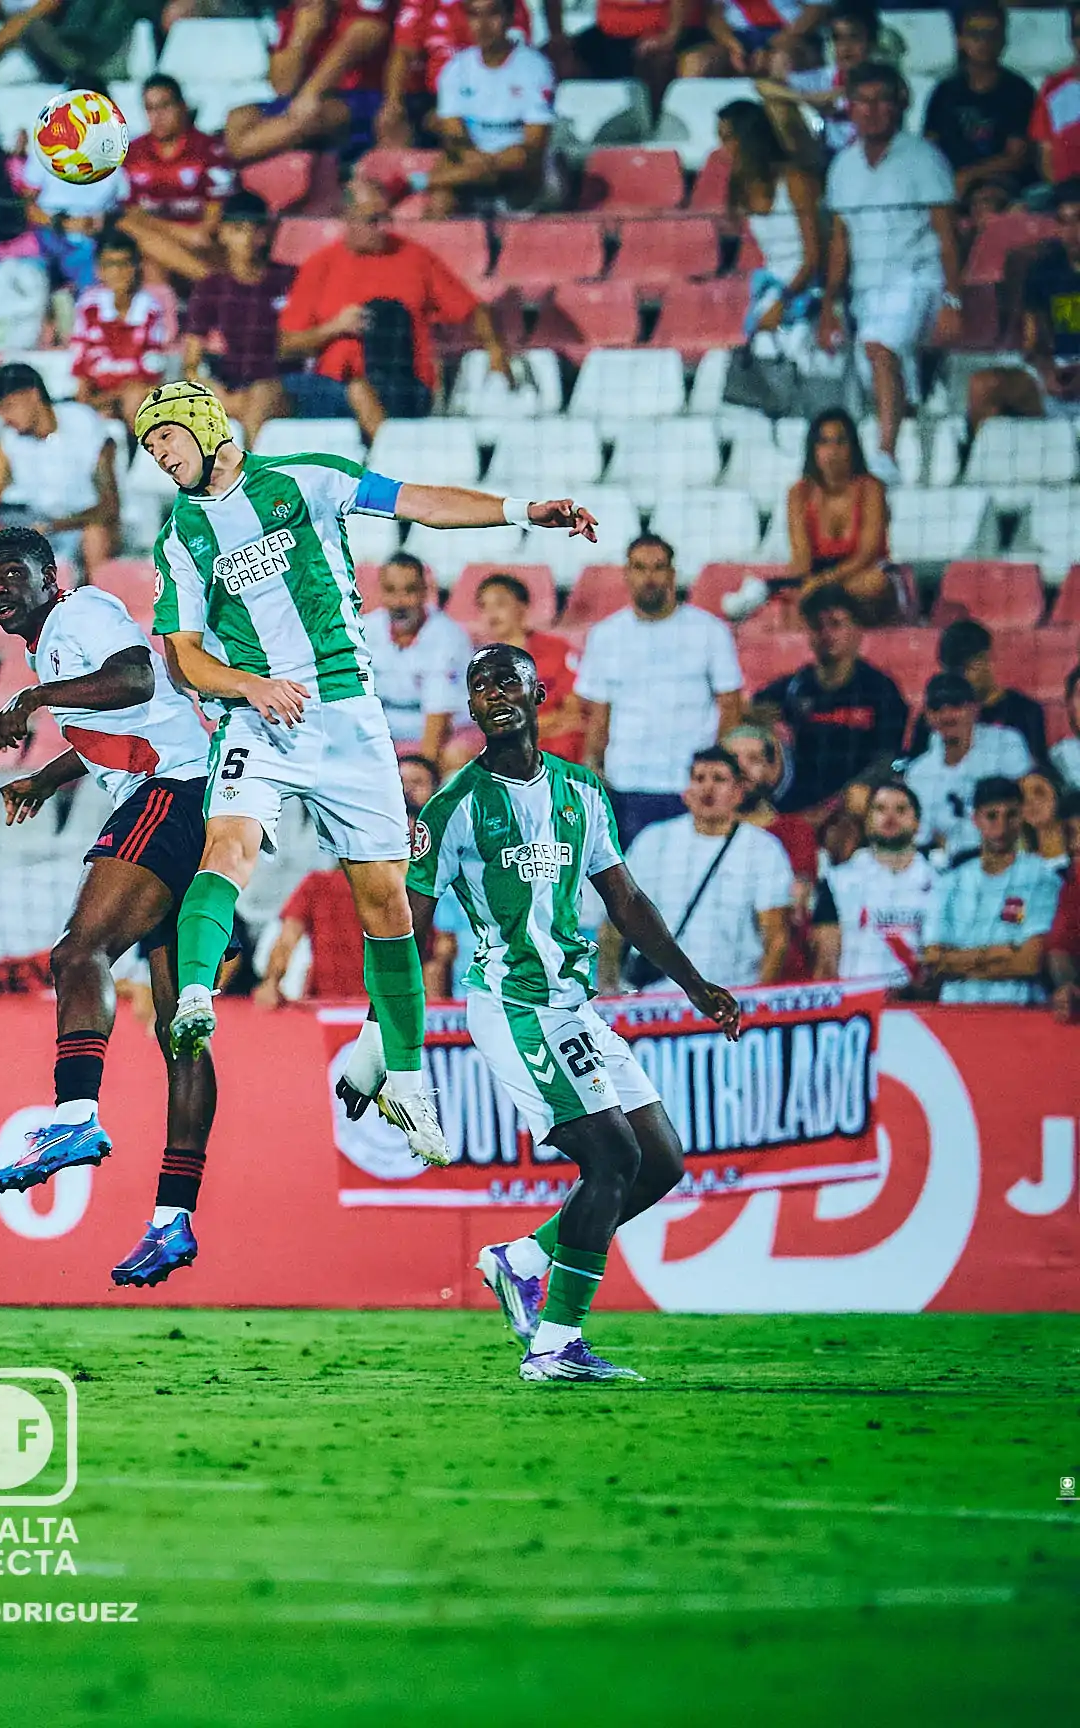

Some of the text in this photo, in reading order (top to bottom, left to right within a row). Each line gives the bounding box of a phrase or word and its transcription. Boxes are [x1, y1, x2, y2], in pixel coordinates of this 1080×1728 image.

[227, 553, 287, 592] GREEN
[220, 747, 250, 780] 5
[521, 861, 558, 878] GREE
